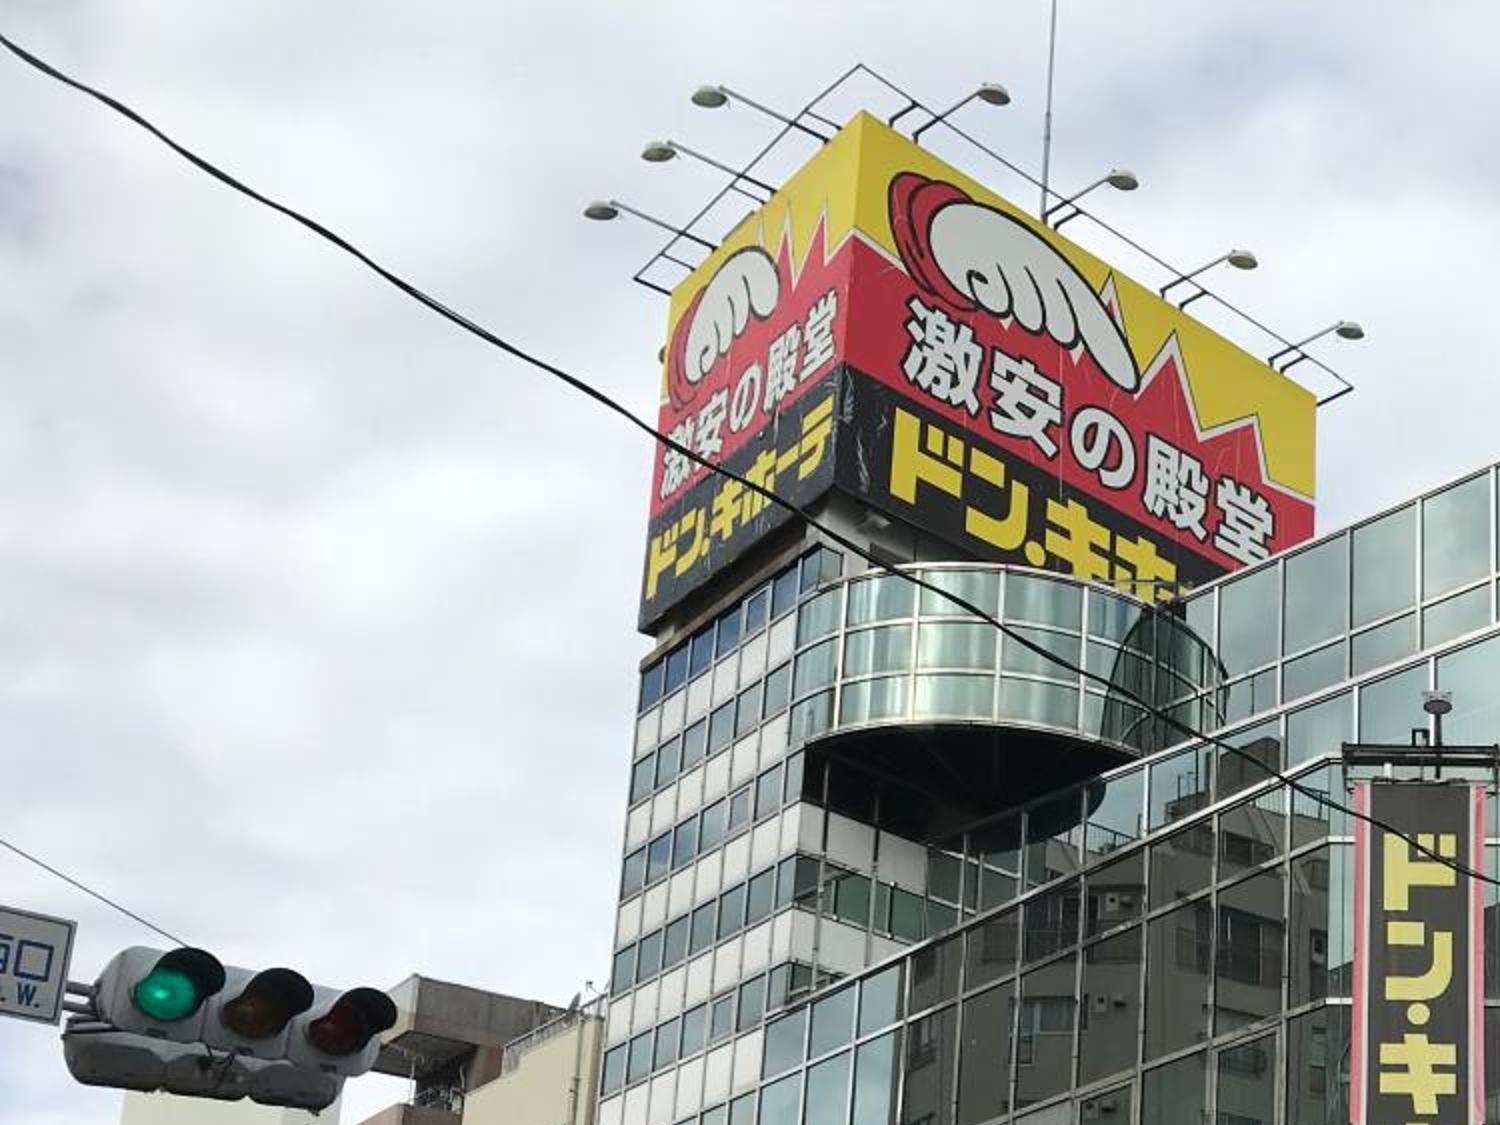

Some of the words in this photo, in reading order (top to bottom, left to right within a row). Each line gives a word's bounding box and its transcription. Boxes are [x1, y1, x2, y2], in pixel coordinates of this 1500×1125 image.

[660, 289, 838, 499] 激安の殿堂
[902, 297, 1273, 566] 激安の殿堂
